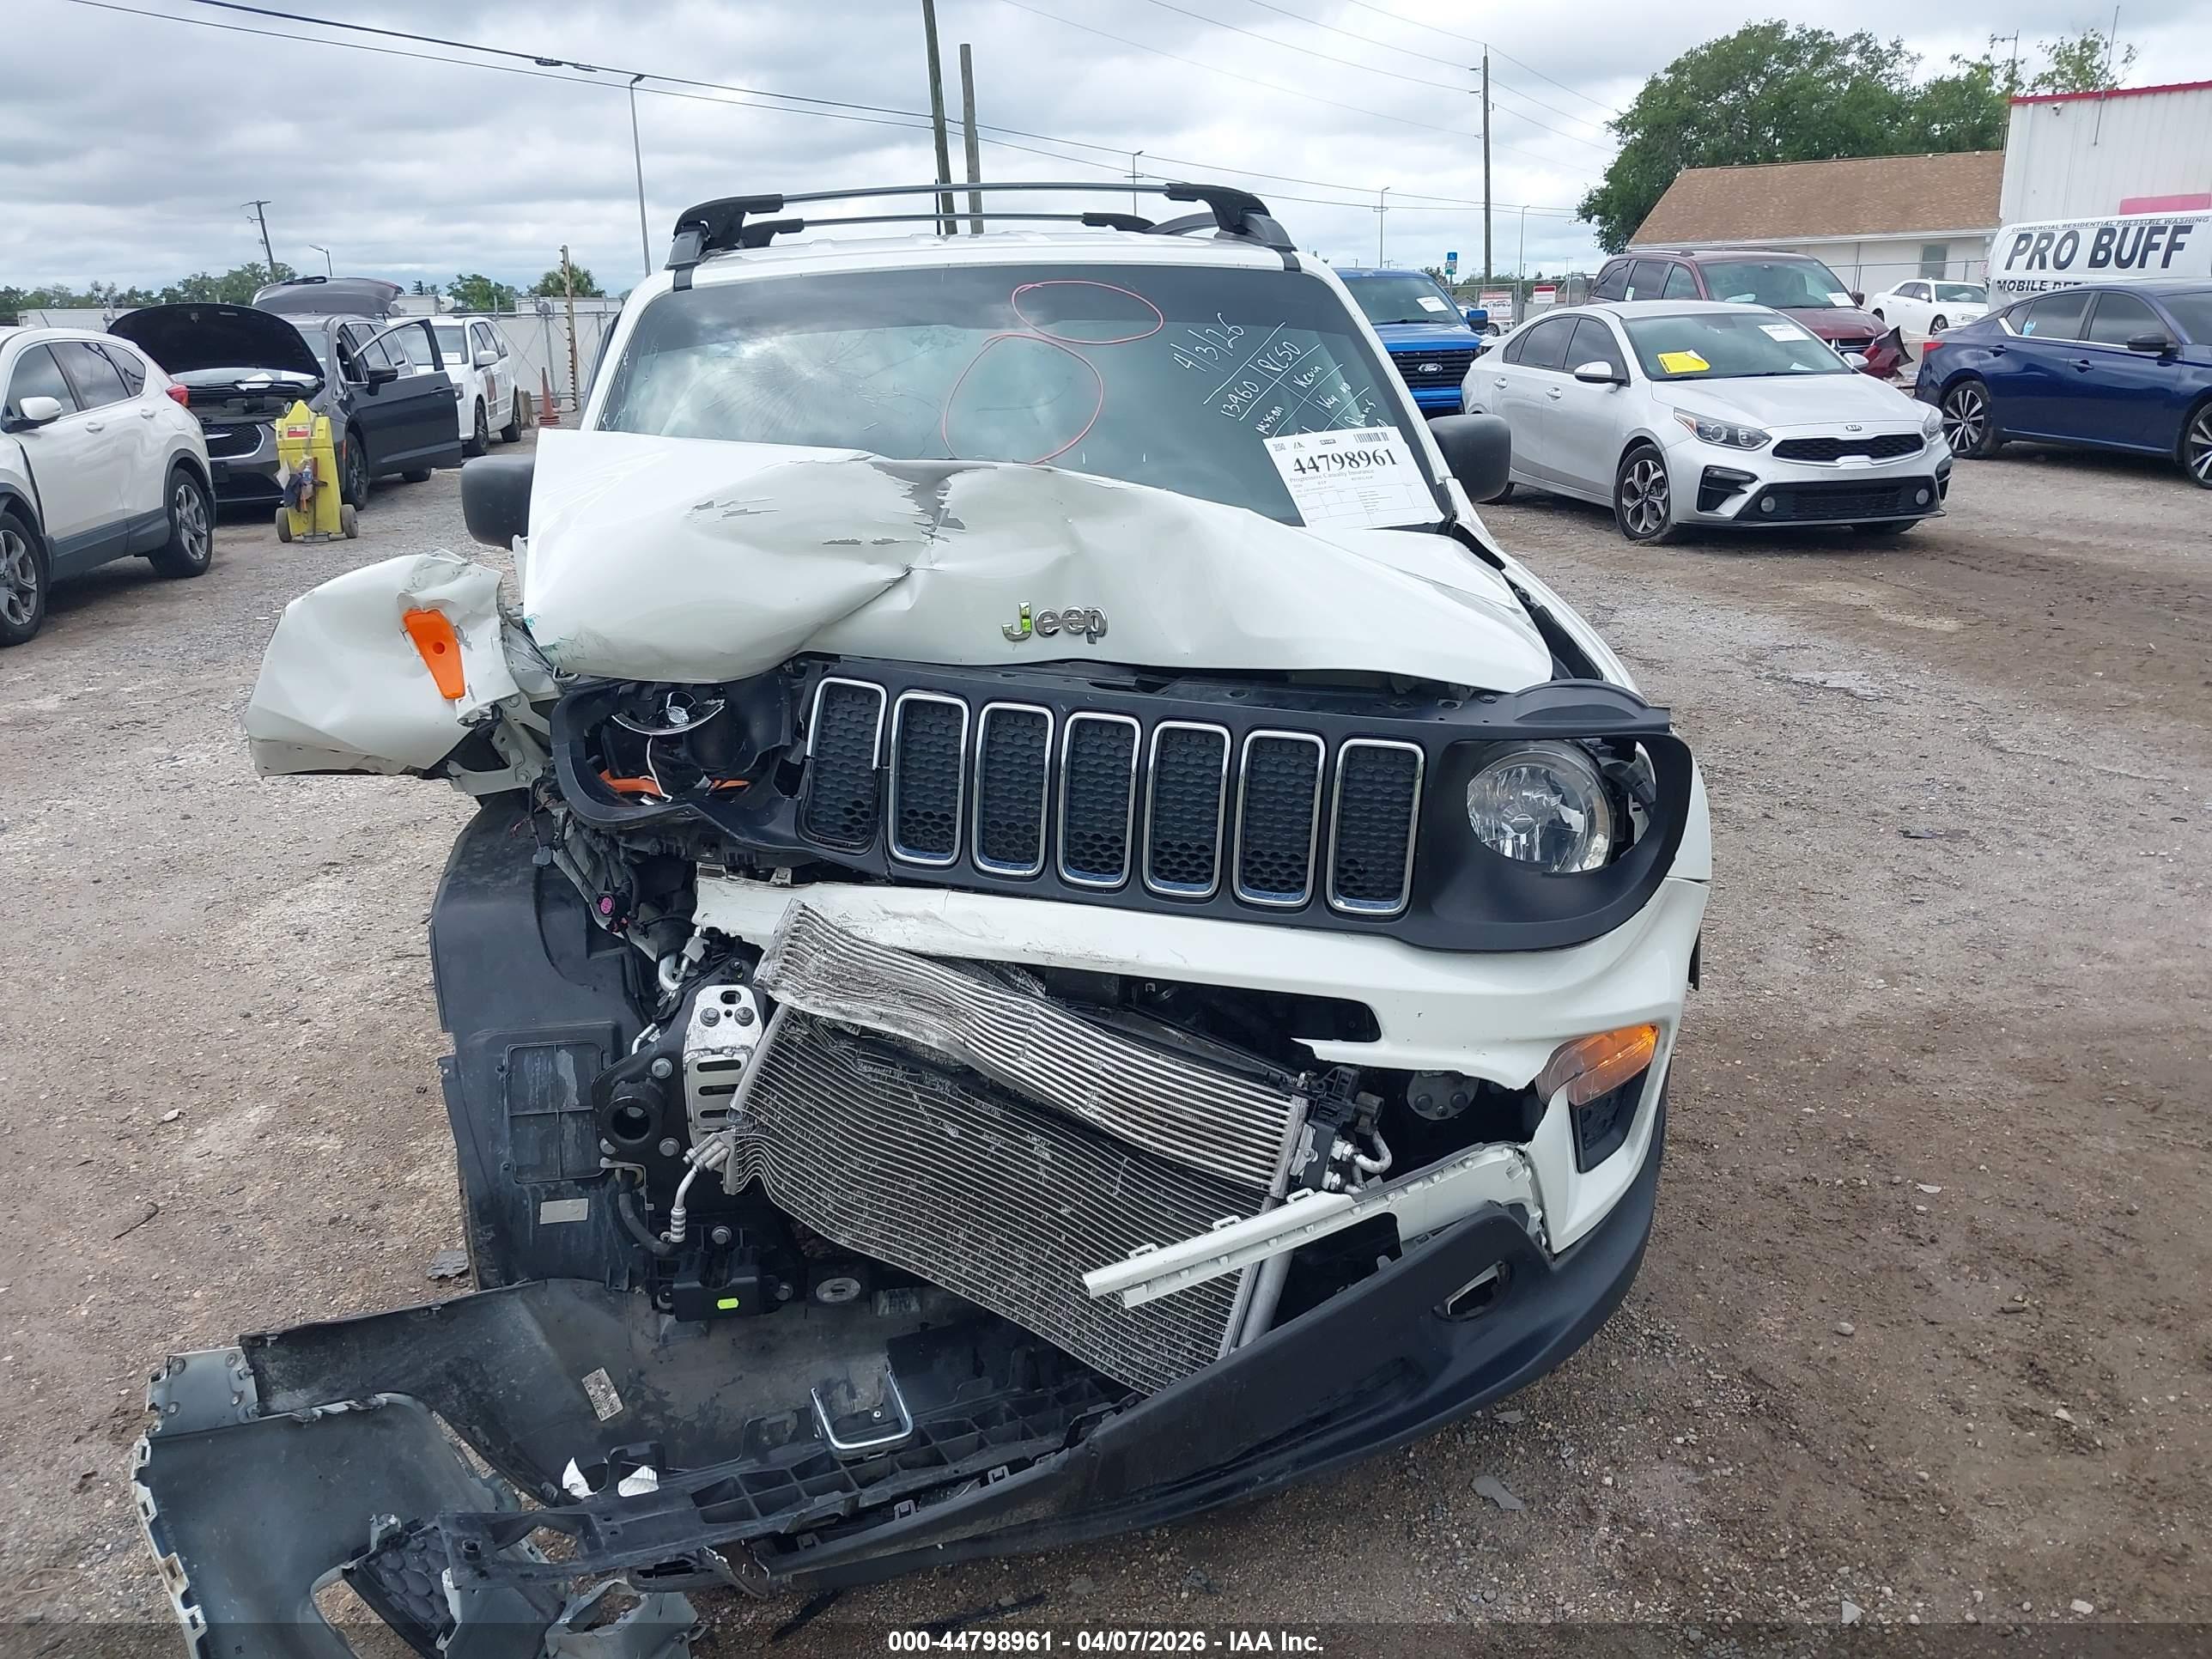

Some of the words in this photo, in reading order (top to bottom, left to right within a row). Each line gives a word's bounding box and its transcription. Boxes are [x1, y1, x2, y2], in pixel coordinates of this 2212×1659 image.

[2011, 224, 2060, 233] COMMERCIAL
[2062, 220, 2116, 229] RESIDENTIAL
[2116, 218, 2163, 228] PRESSURE
[2163, 216, 2210, 225] WASHING
[2004, 230, 2081, 271] PRO
[2087, 224, 2193, 270] BUFF
[1996, 279, 2048, 292] MOBILE
[1292, 365, 1323, 388] Kevin
[1220, 380, 1260, 417] 13960
[1316, 394, 1340, 409] Key
[1293, 448, 1398, 475] 44798961
[1001, 600, 1109, 645] Jeep
